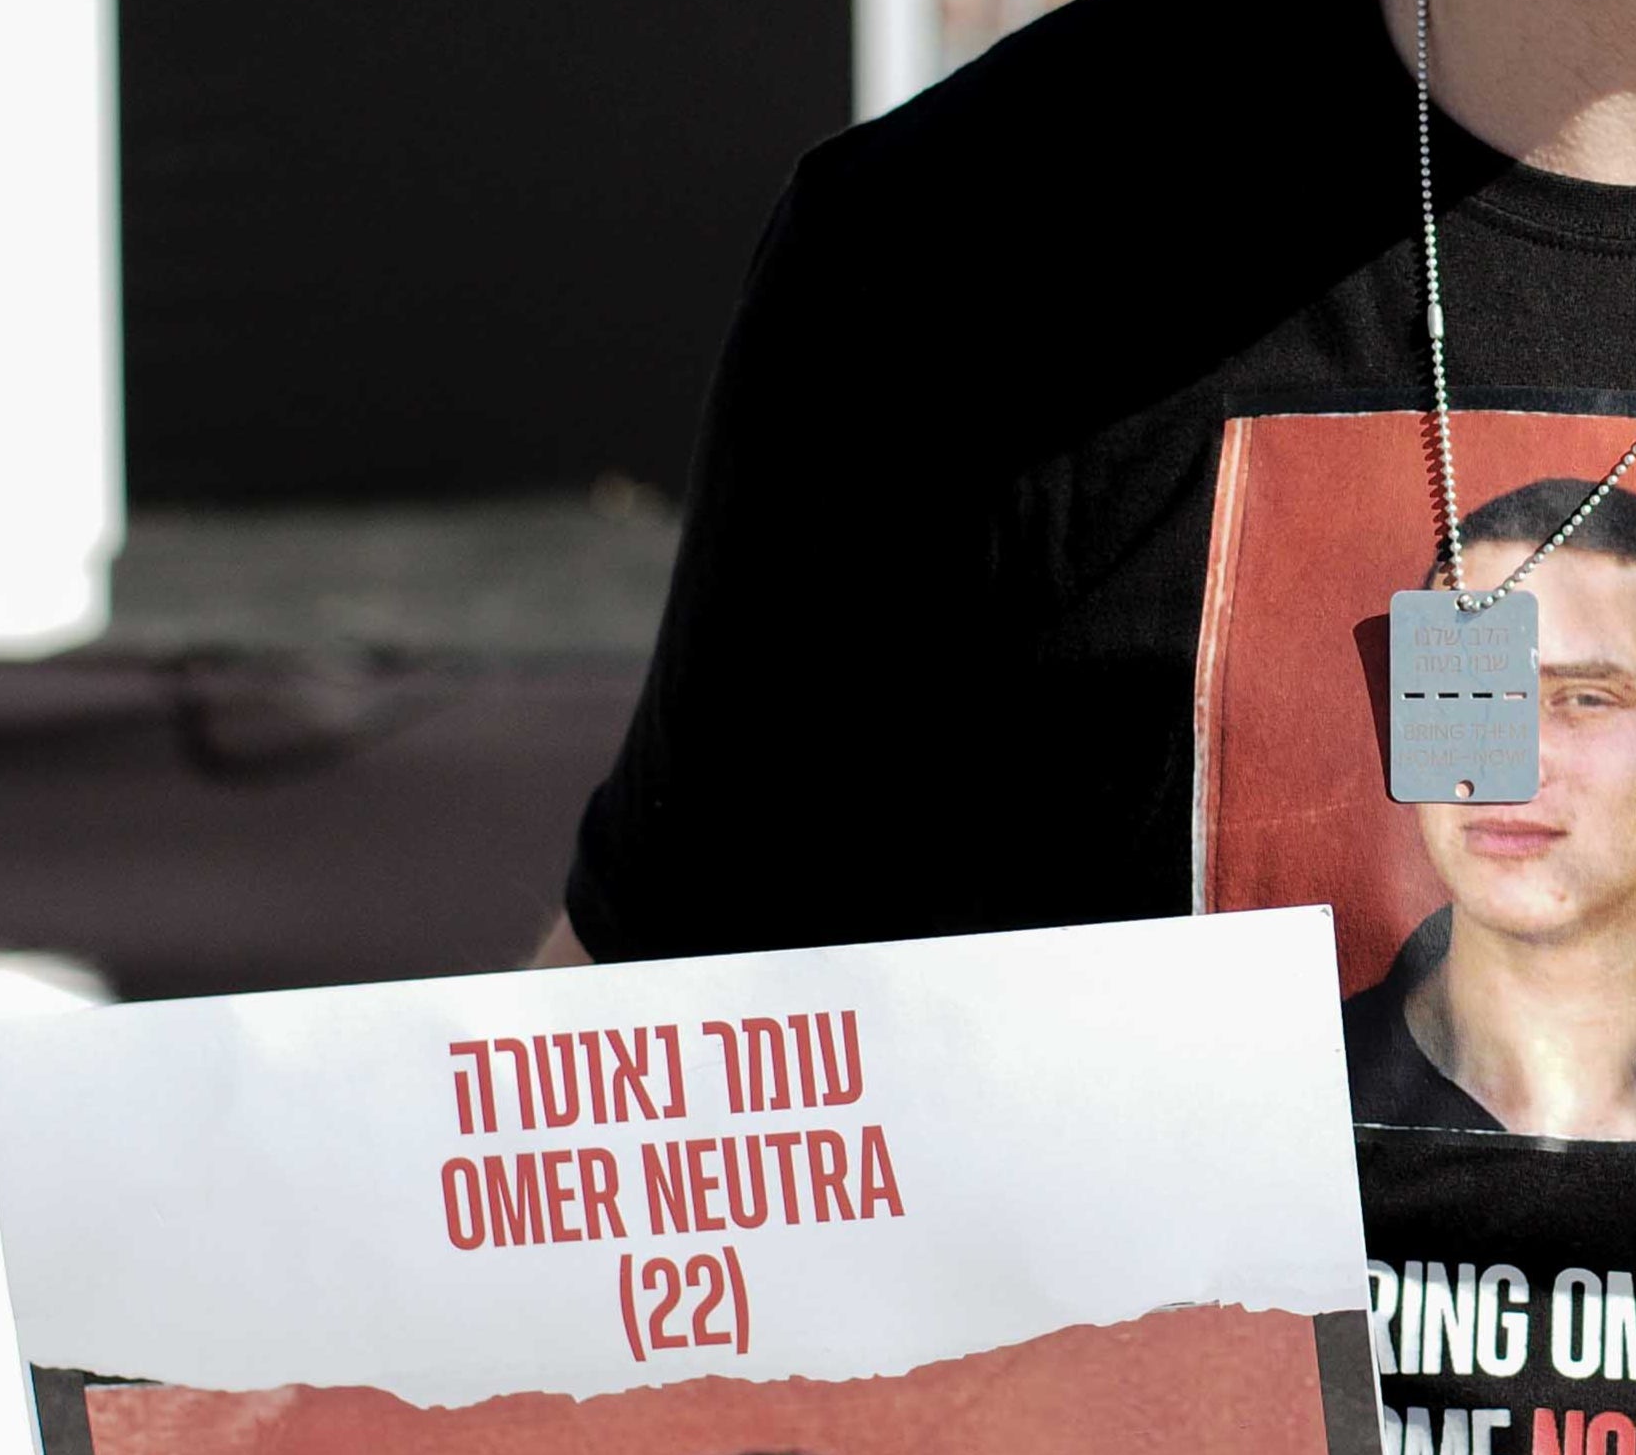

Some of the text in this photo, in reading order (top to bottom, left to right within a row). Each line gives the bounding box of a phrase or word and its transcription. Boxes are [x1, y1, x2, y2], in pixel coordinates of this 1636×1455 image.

[1403, 722, 1465, 741] BRING
[449, 1010, 863, 1135] עומר נאוטרה
[441, 1125, 906, 1251] OMER NEUTRA
[619, 1246, 749, 1362] (22)
[1366, 1259, 1530, 1377] RING
